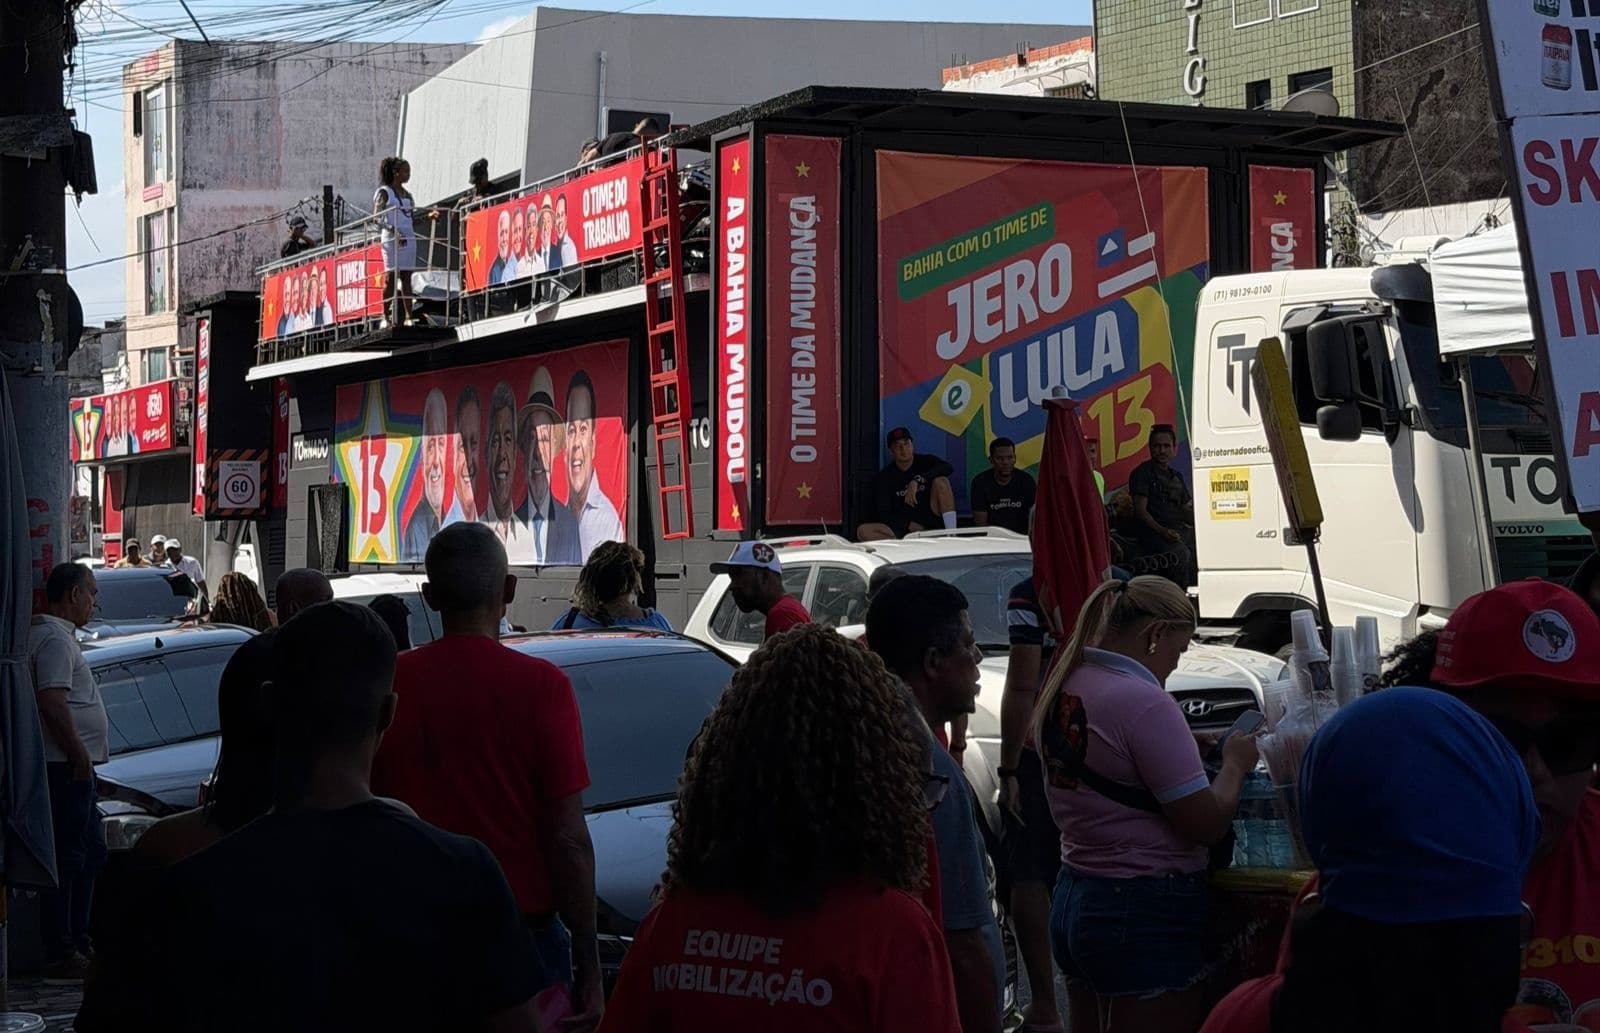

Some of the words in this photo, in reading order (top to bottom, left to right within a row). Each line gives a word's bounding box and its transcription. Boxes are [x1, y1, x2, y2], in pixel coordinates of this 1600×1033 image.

[583, 188, 590, 218] O
[590, 180, 614, 216] TIME
[614, 175, 628, 209] DO
[727, 196, 745, 222] A
[583, 209, 631, 251] TRABALHO
[903, 250, 943, 282] BAHIA
[946, 235, 979, 263] COM
[982, 231, 991, 249] O
[994, 215, 1028, 244] TIME
[1030, 207, 1048, 230] DE
[726, 226, 745, 338] BAHIA
[789, 195, 820, 330] MUDANÇA
[935, 242, 1073, 360] JERO
[1214, 289, 1228, 301] (71)
[791, 335, 817, 369] DA
[999, 310, 1125, 419] LULA
[726, 343, 745, 484] MUDOU
[790, 372, 817, 440] TIME
[1087, 374, 1155, 469] 13
[293, 438, 329, 461] TORNADO
[790, 444, 817, 464] O
[232, 480, 248, 492] 60
[358, 434, 388, 535] 13
[1211, 480, 1248, 493] VISTORIADO
[1256, 530, 1277, 539] 440
[1496, 525, 1544, 534] VOLVO
[683, 928, 784, 965] EQUIPE
